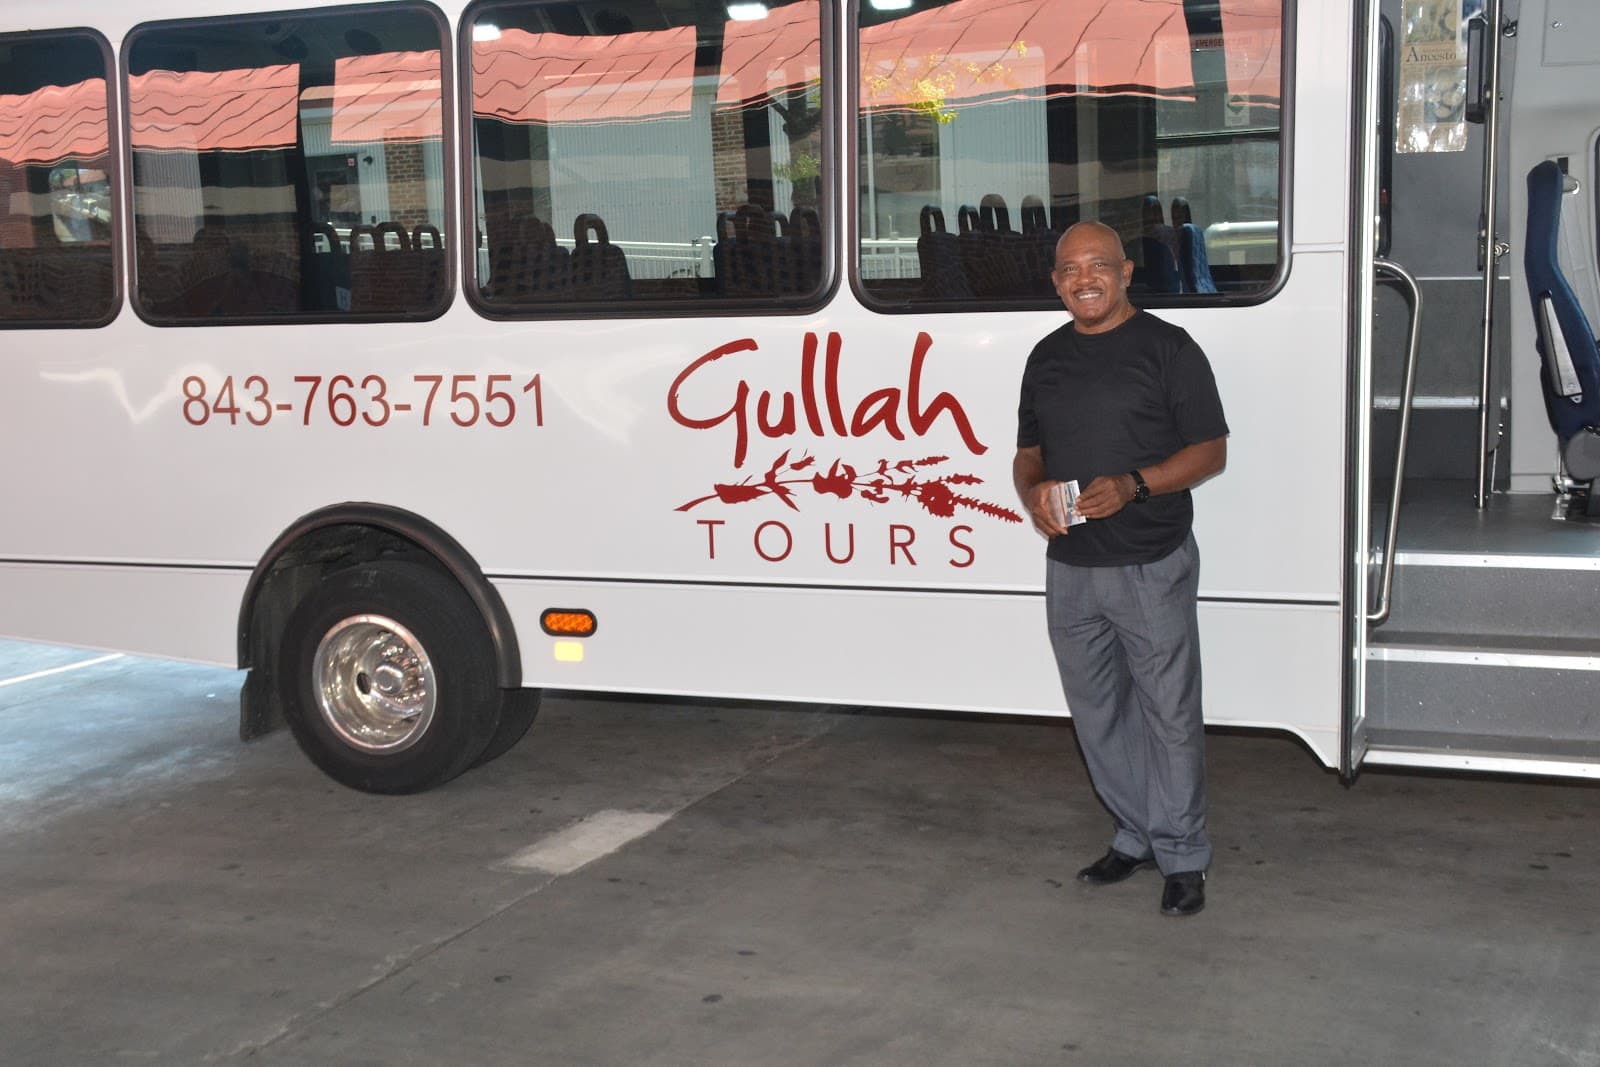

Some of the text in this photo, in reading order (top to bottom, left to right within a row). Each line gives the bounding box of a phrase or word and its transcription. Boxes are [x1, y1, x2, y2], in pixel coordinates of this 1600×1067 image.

[182, 374, 544, 427] 843-763-7551
[667, 331, 988, 470] Gullah
[697, 520, 976, 569] TOURS
